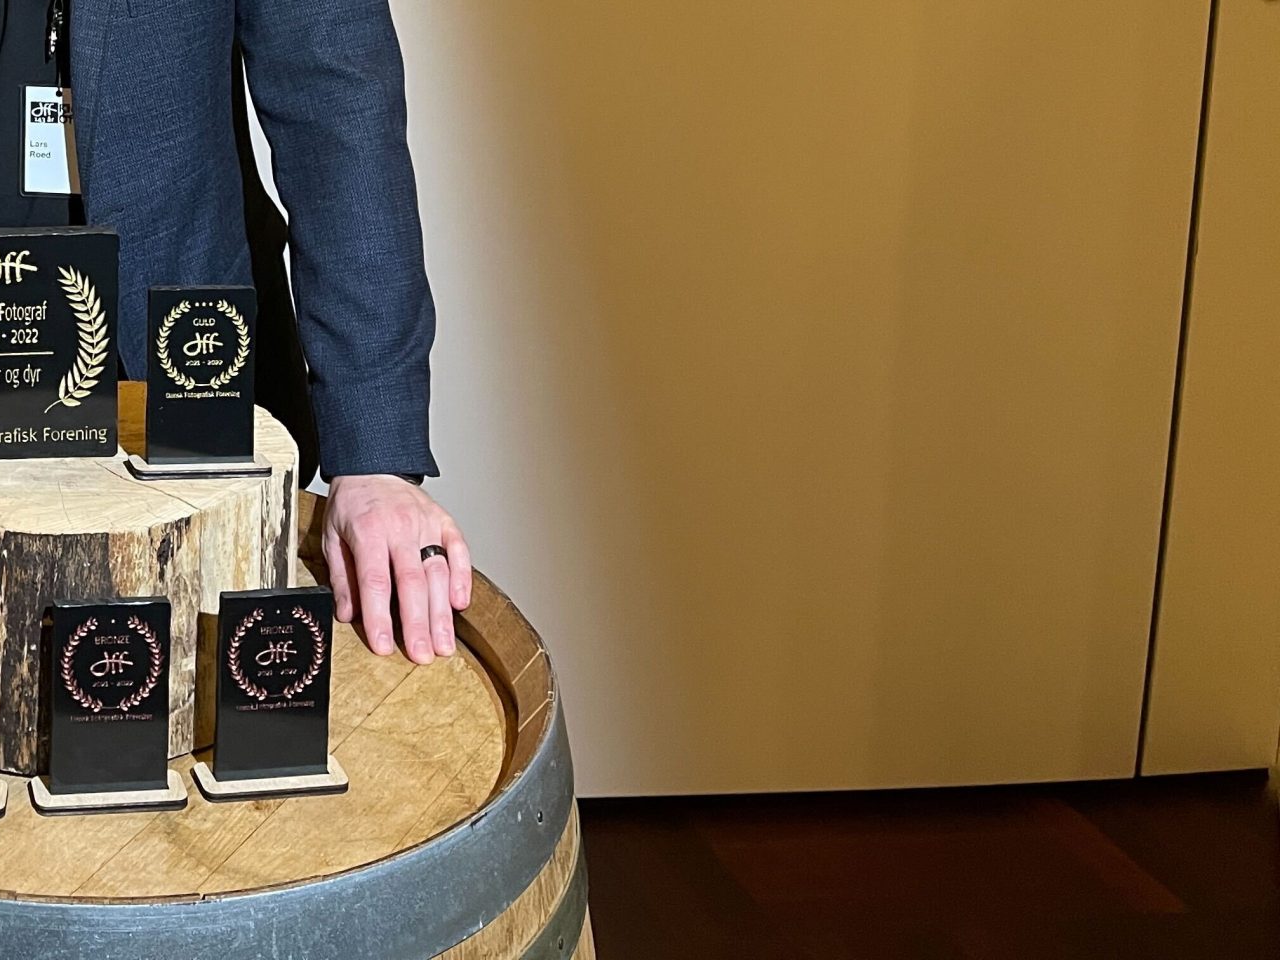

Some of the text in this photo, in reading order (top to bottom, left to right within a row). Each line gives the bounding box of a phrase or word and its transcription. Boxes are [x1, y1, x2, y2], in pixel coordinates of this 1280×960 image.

[29, 140, 48, 148] Lars
[0, 300, 48, 326] Fotograf
[192, 317, 216, 327] GULD
[10, 328, 39, 345] 2022
[5, 368, 20, 388] og
[23, 363, 41, 387] dyr
[43, 425, 108, 444] Forening
[94, 635, 131, 645] BRONZE
